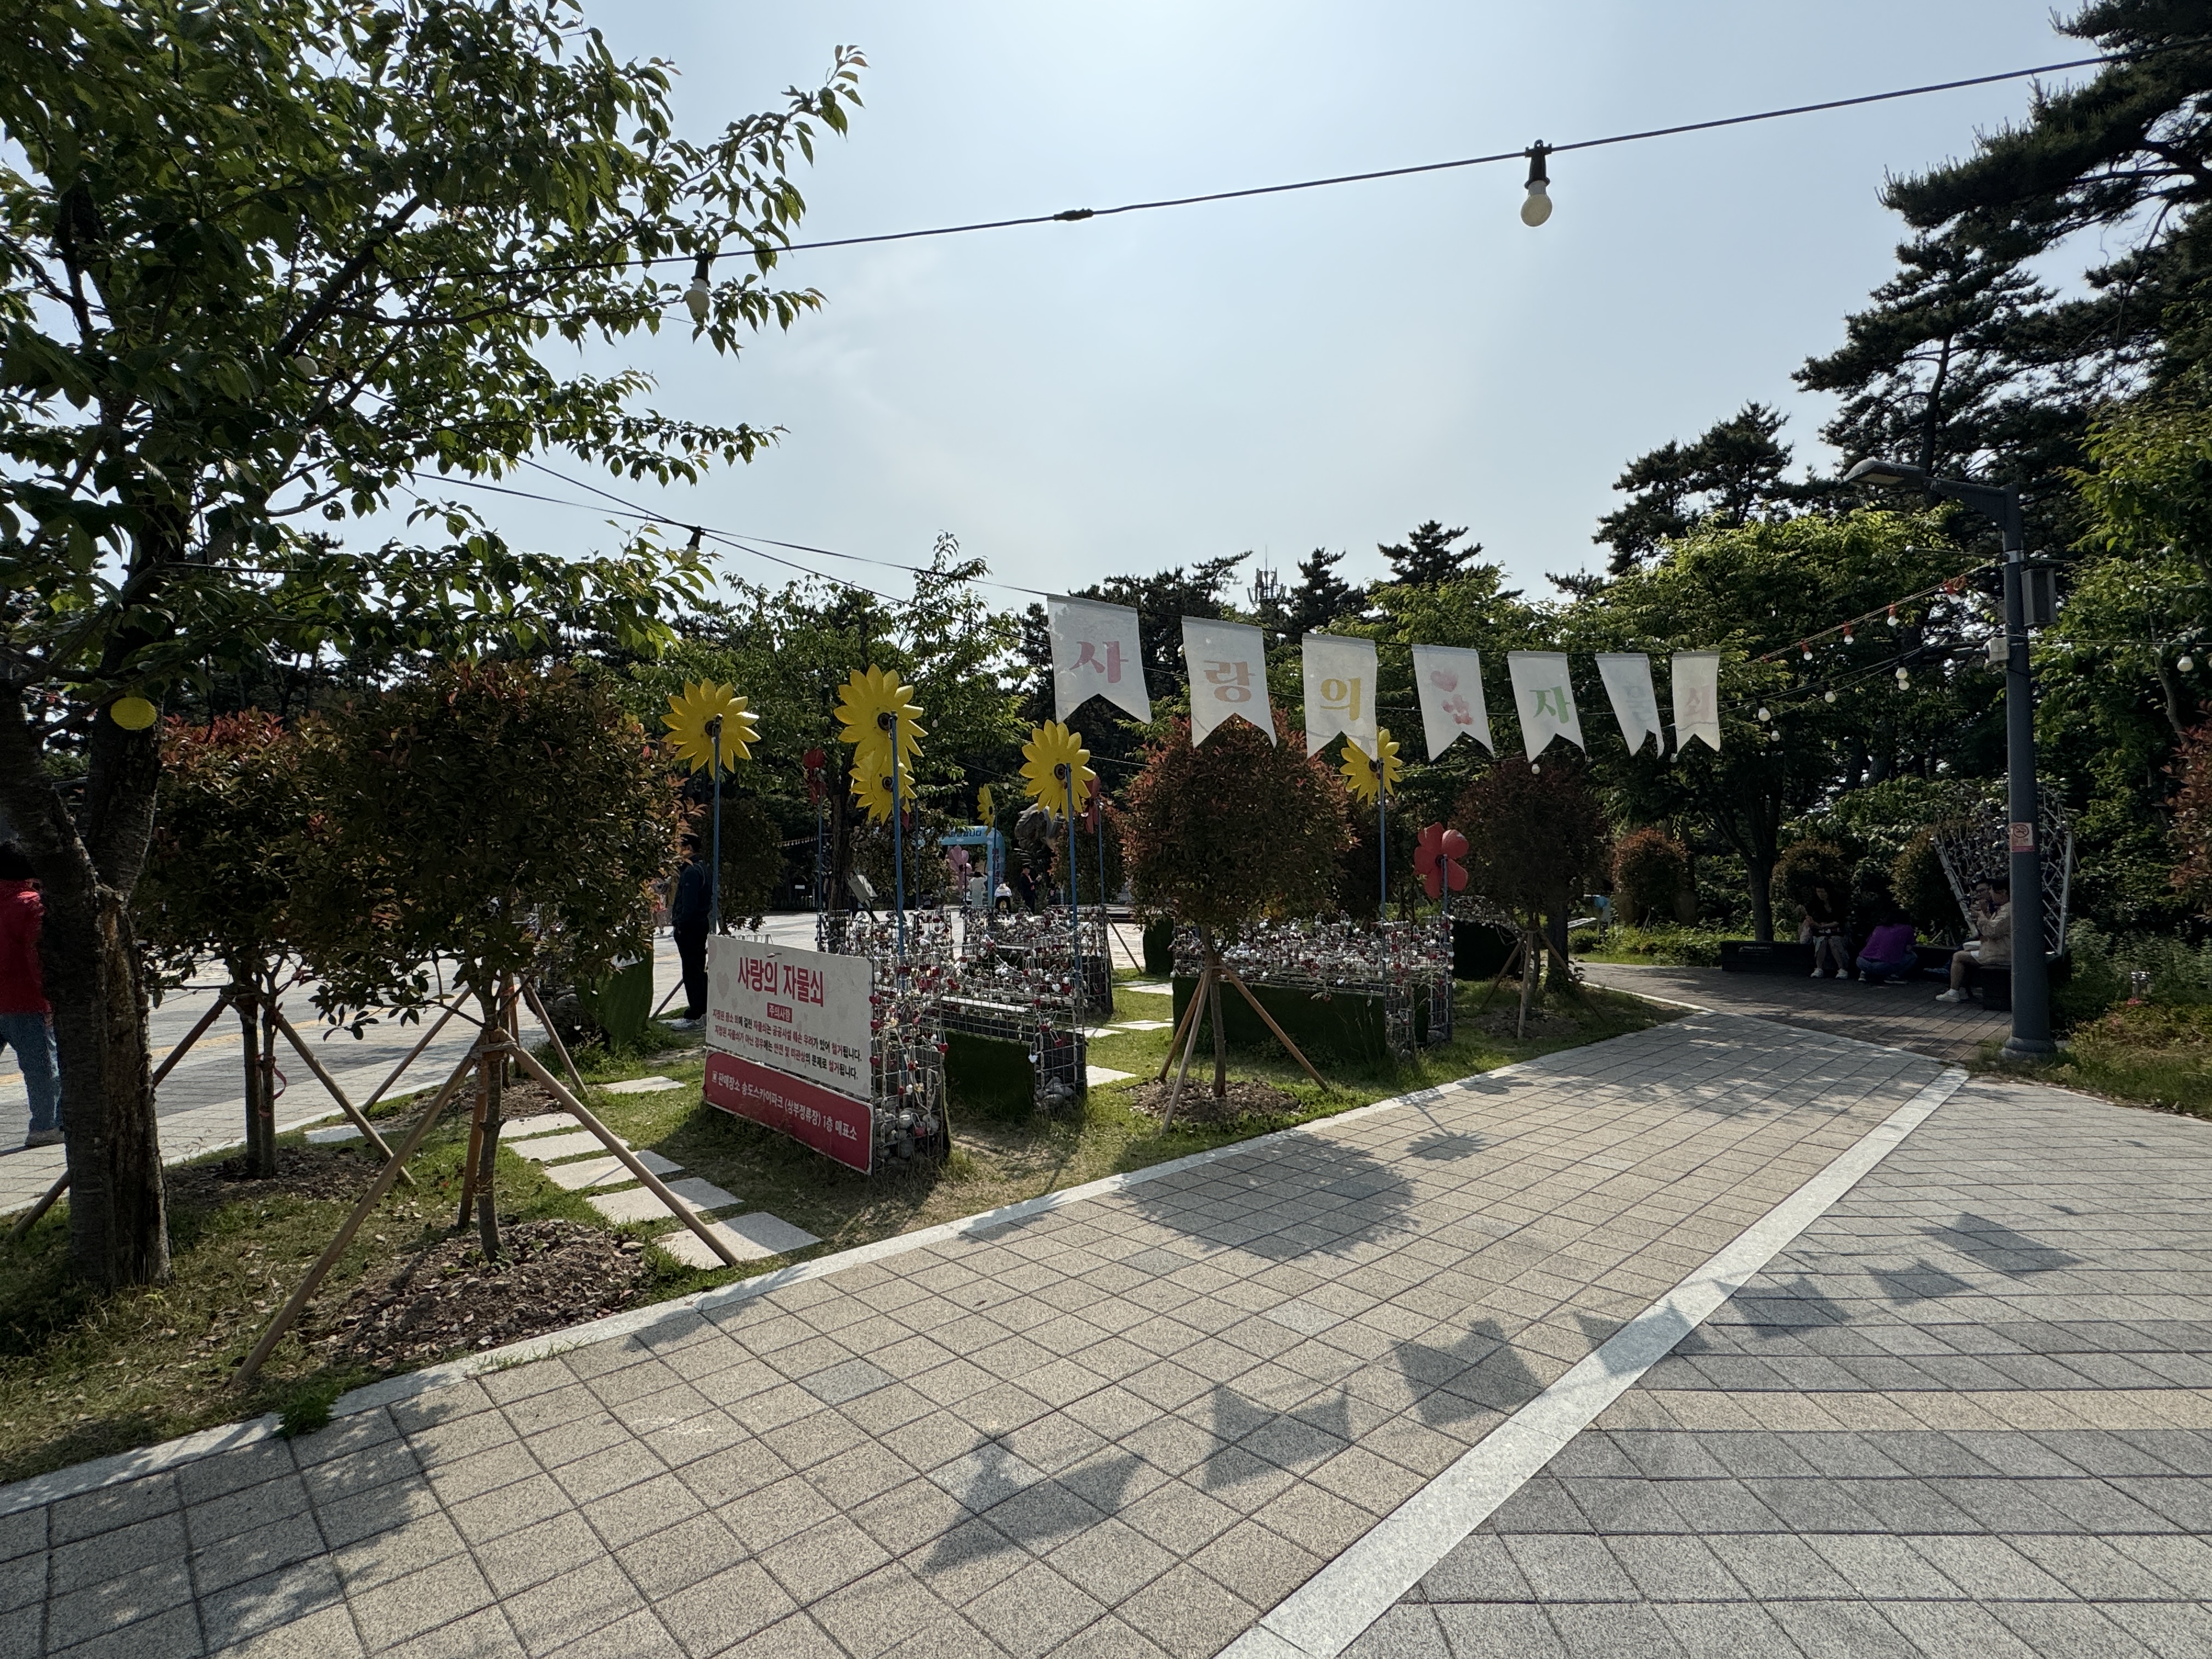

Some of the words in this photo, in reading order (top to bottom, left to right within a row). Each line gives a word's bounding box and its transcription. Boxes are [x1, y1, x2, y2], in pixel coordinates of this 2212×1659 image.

[737, 957, 778, 996] 사랑의
[783, 964, 824, 1007] 자물쇠
[712, 1008, 725, 1022] 지정된
[725, 1012, 734, 1023] 장소
[753, 1019, 772, 1035] 자물쇠는
[772, 1025, 792, 1041] 공공시설
[803, 1034, 819, 1050] 우려가
[819, 1039, 831, 1053] 있어
[831, 1042, 862, 1063] 철거됩니다.
[769, 1005, 791, 1022] 주의사항
[714, 1024, 727, 1038] 지정된
[727, 1029, 744, 1043] 자물쇠가
[755, 1036, 773, 1053] 경우에는
[774, 1042, 783, 1056] 안전
[811, 1054, 827, 1069] 문제로
[828, 1059, 859, 1080] 철거됩니다.
[718, 1073, 741, 1092] 판매장소
[741, 1081, 784, 1109] 송도스카이파크
[785, 1098, 821, 1127] (상부정류장)
[822, 1115, 833, 1133] 1층
[834, 1119, 857, 1141] 매표소
